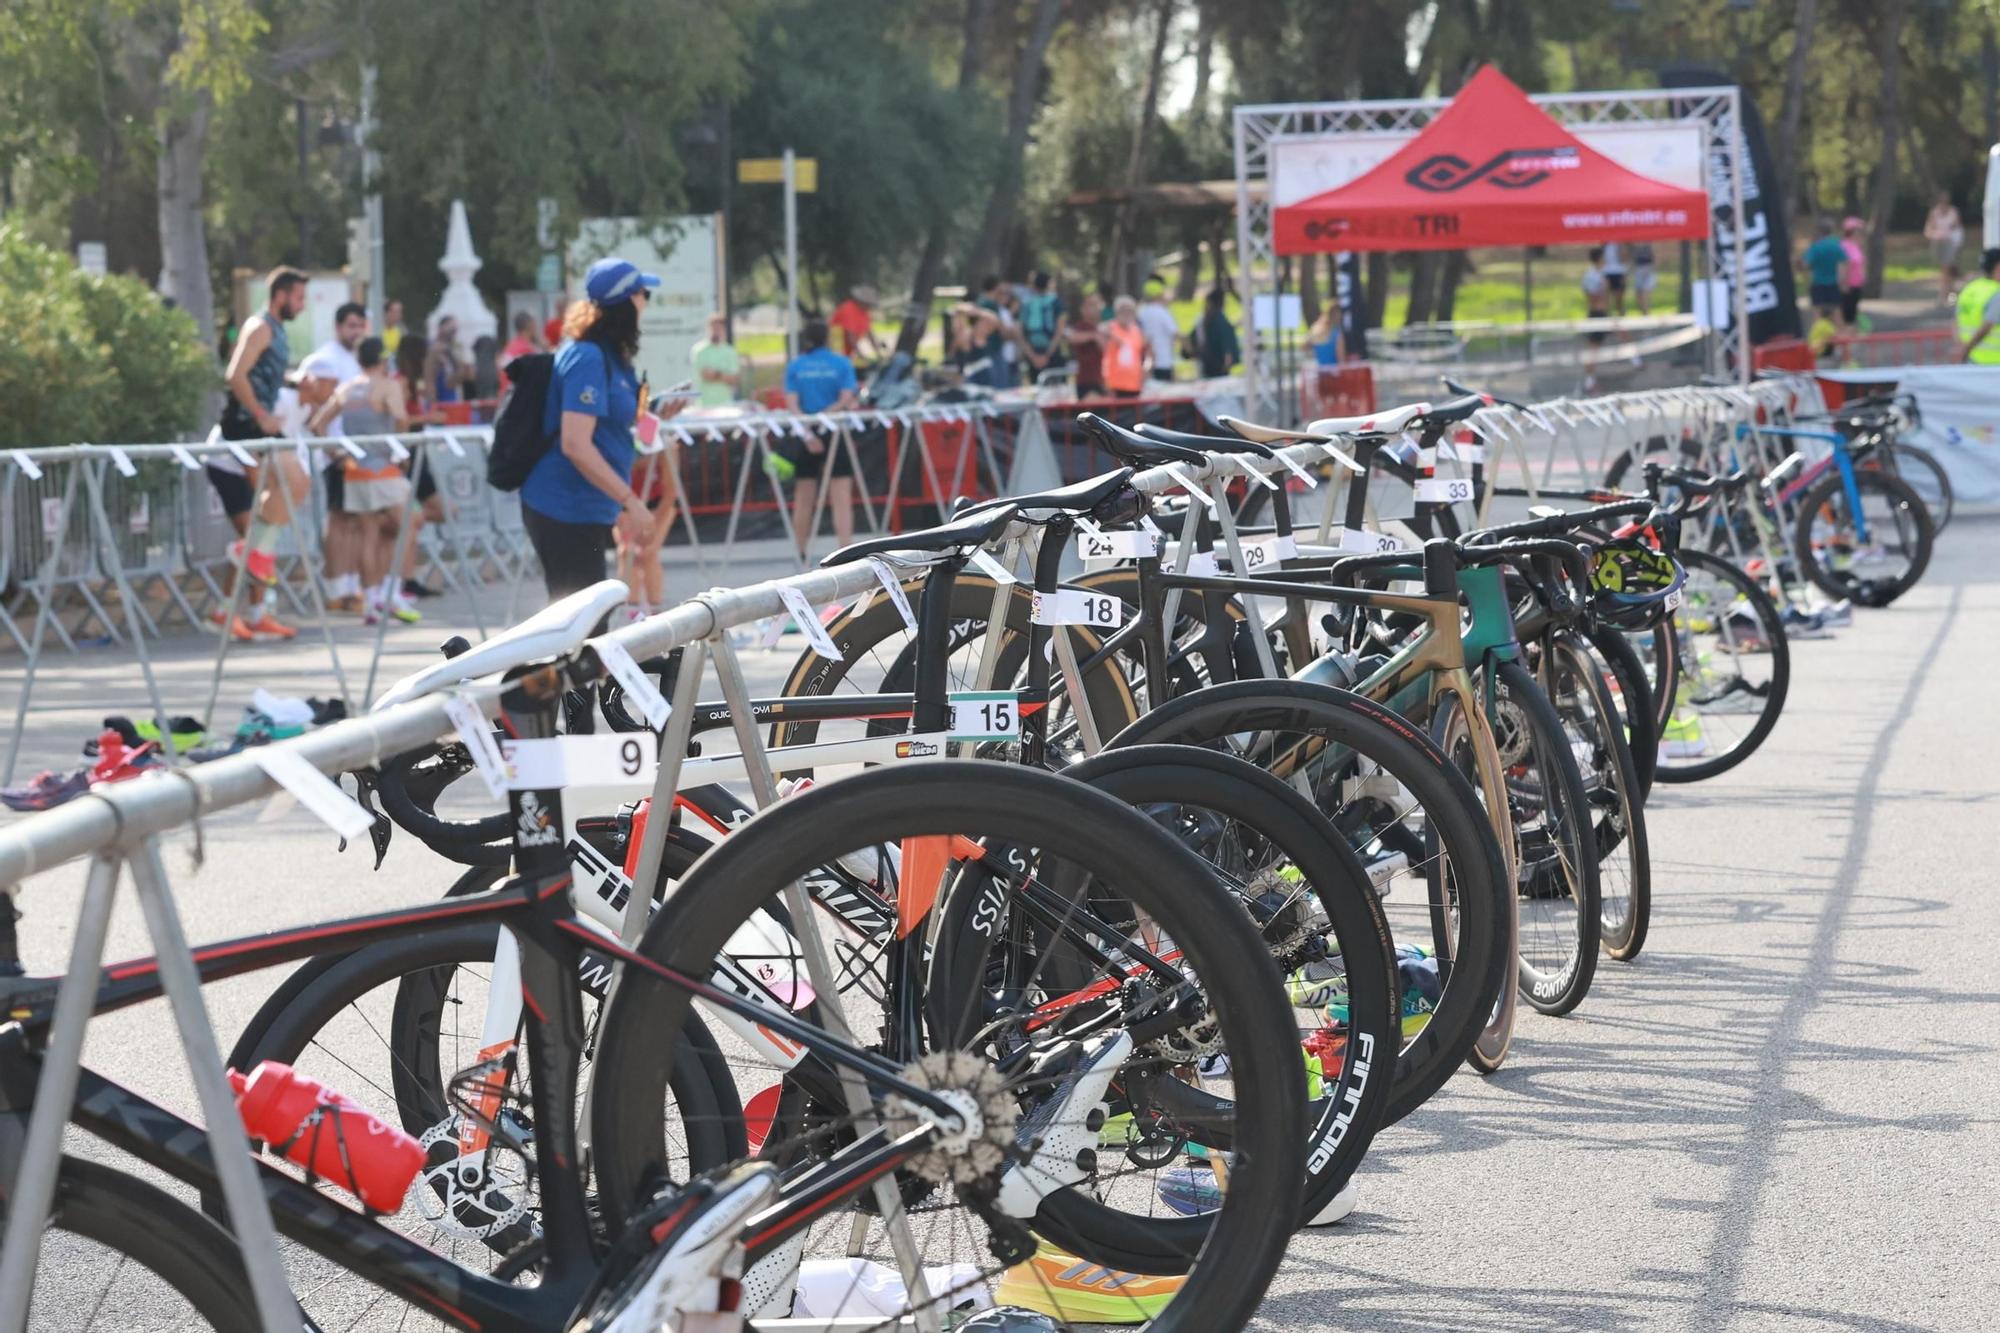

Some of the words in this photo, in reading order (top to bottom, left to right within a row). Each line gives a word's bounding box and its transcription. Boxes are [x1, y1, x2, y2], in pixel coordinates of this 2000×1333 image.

[1713, 212, 1779, 316] BIKE
[1448, 483, 1468, 498] 33
[1088, 536, 1114, 557] 24
[1378, 538, 1396, 551] 30
[1246, 547, 1265, 567] 29
[1084, 597, 1113, 623] 18
[981, 703, 1010, 732] 15
[621, 739, 642, 776] 9
